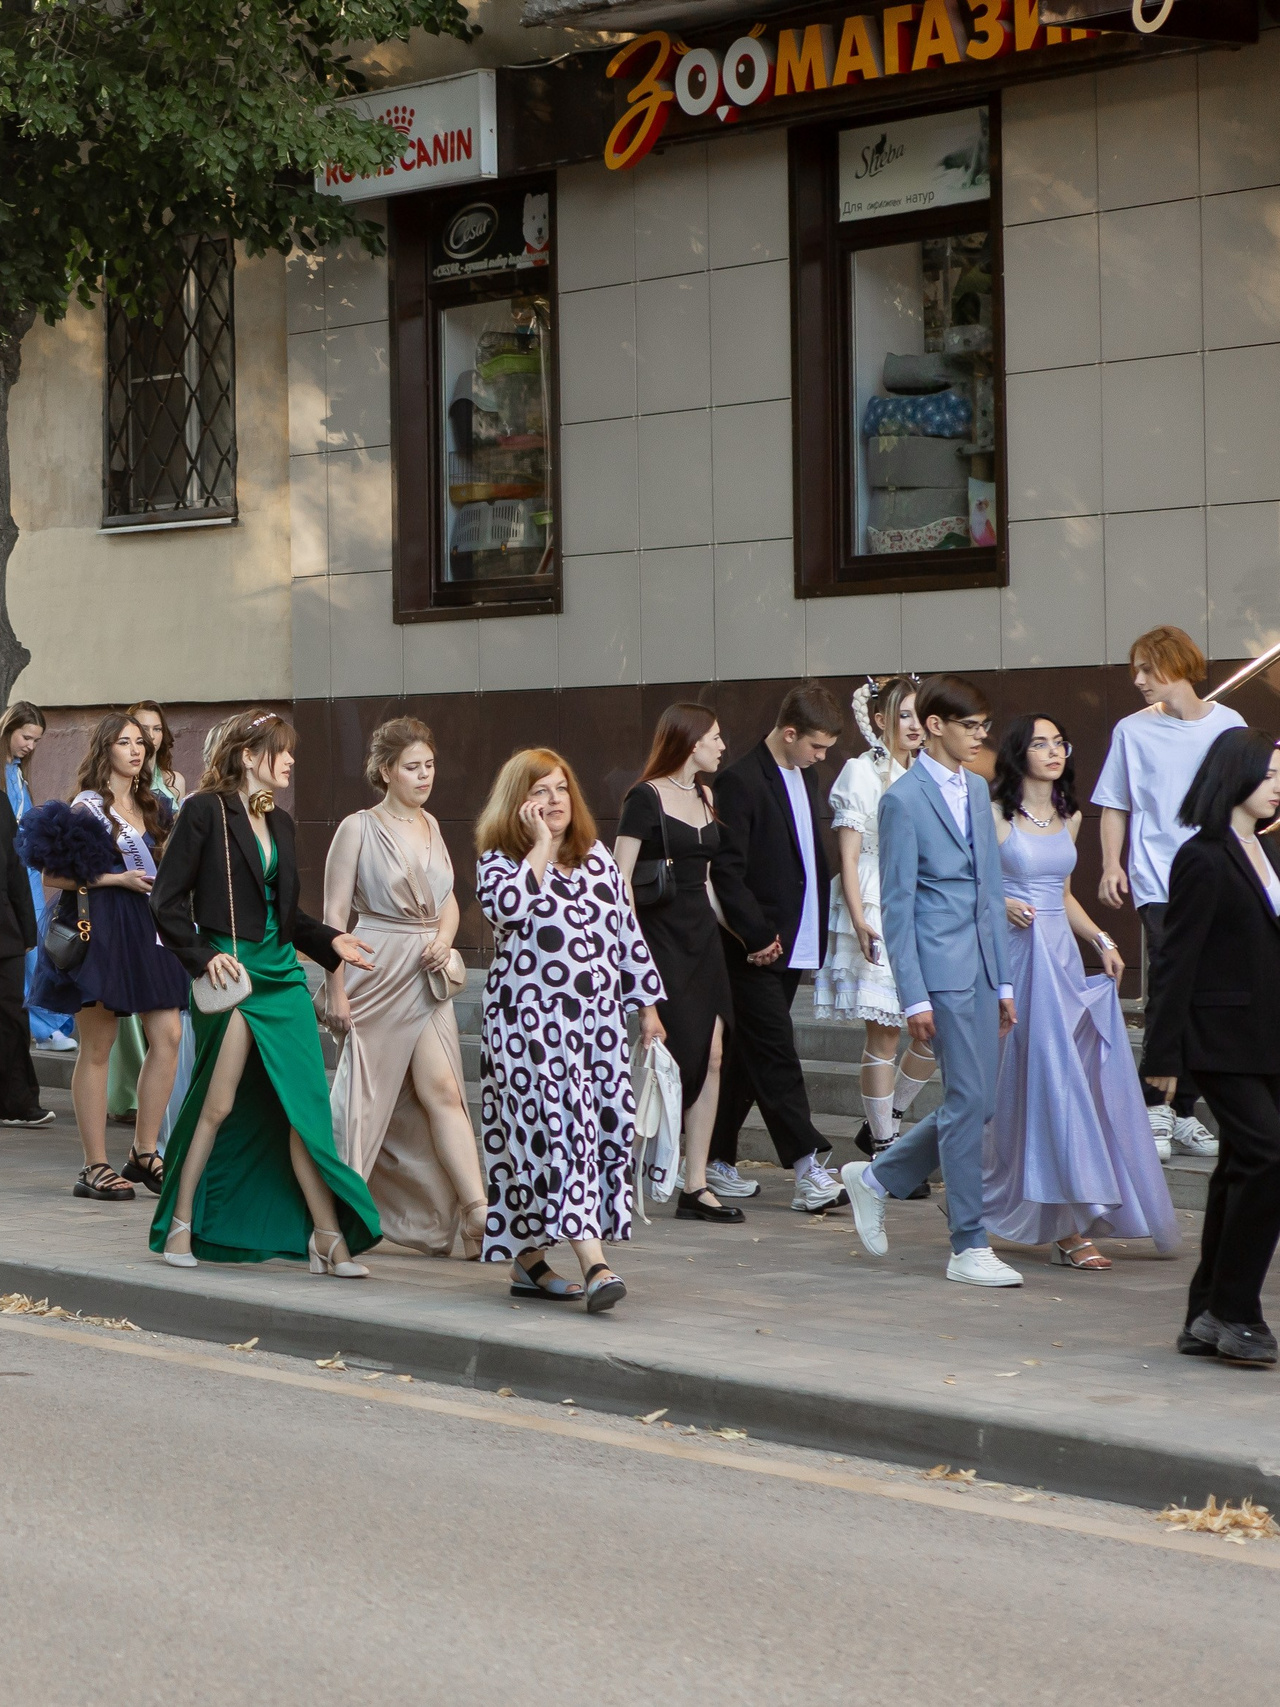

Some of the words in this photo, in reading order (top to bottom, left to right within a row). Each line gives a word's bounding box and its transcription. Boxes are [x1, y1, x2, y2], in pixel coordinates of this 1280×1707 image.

[605, 0, 1114, 170] ЗООМАГАЗИ
[400, 127, 473, 171] CANIN
[855, 142, 905, 180] Sheba
[842, 201, 863, 216] Для
[906, 191, 935, 206] натур
[450, 216, 491, 250] Cesar
